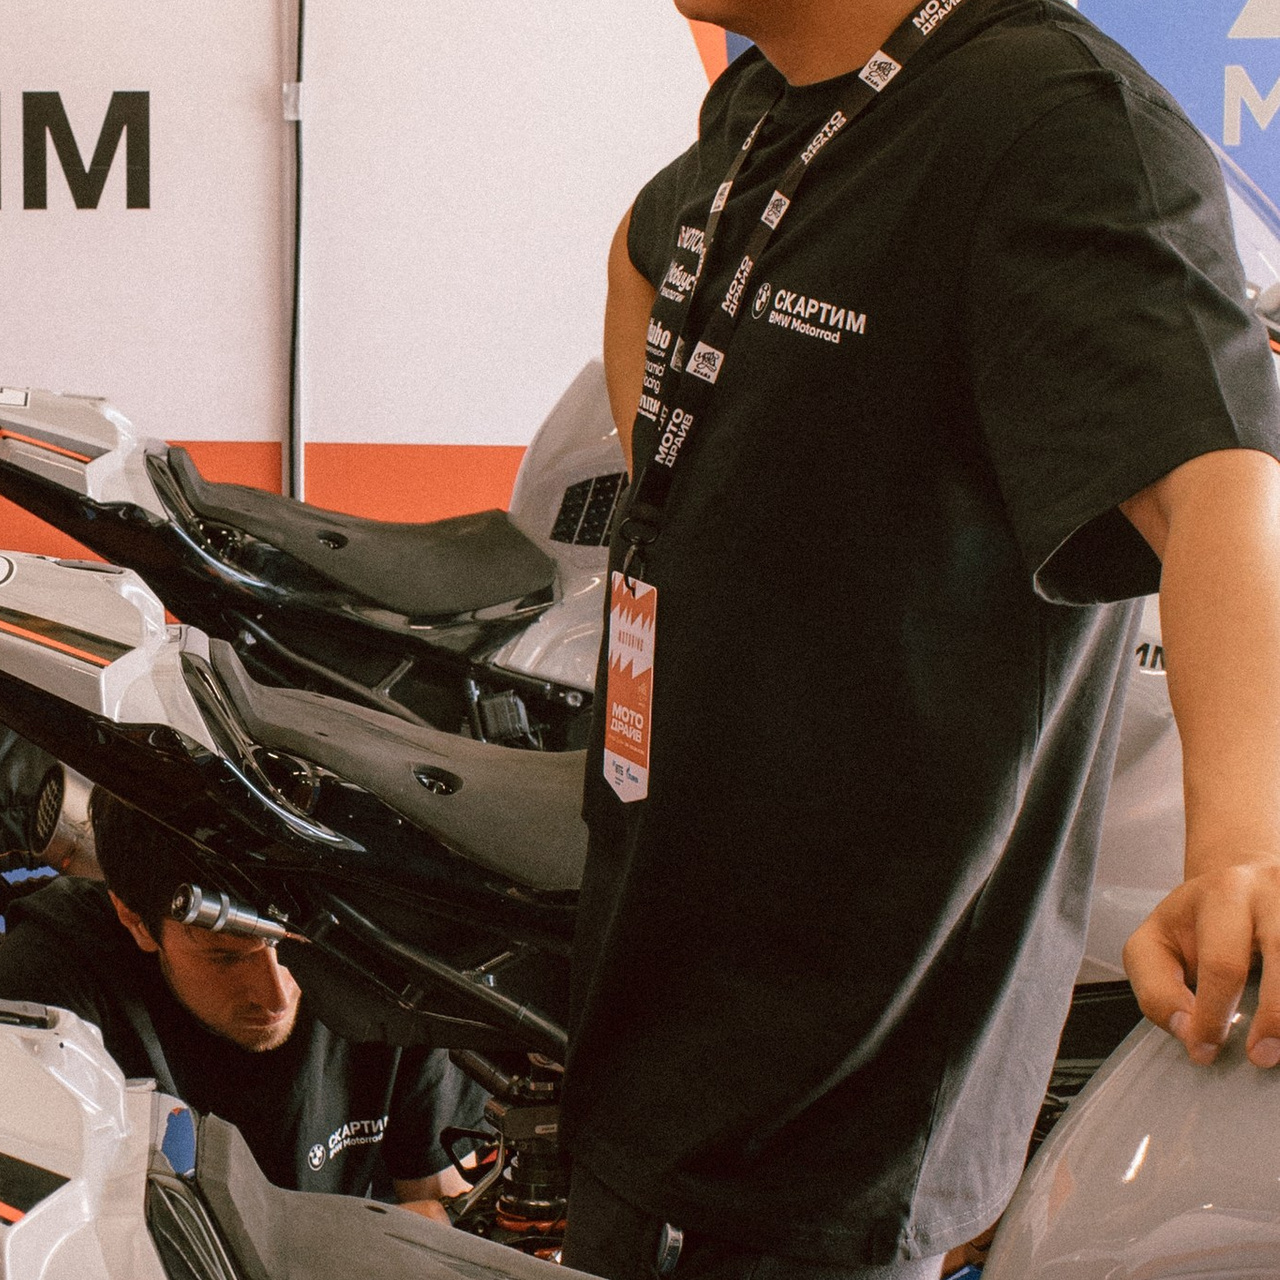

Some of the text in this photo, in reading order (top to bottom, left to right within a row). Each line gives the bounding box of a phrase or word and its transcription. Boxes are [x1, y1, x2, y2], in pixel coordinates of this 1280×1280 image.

[721, 254, 750, 313] МОТО
[768, 310, 841, 344] BMW Motorrad
[773, 288, 868, 335] СКАРТИМ
[654, 407, 685, 465] МОТО
[665, 413, 695, 469] ДРАЙВ
[609, 721, 644, 745] ДРАЙВ
[611, 701, 645, 731] МОТО
